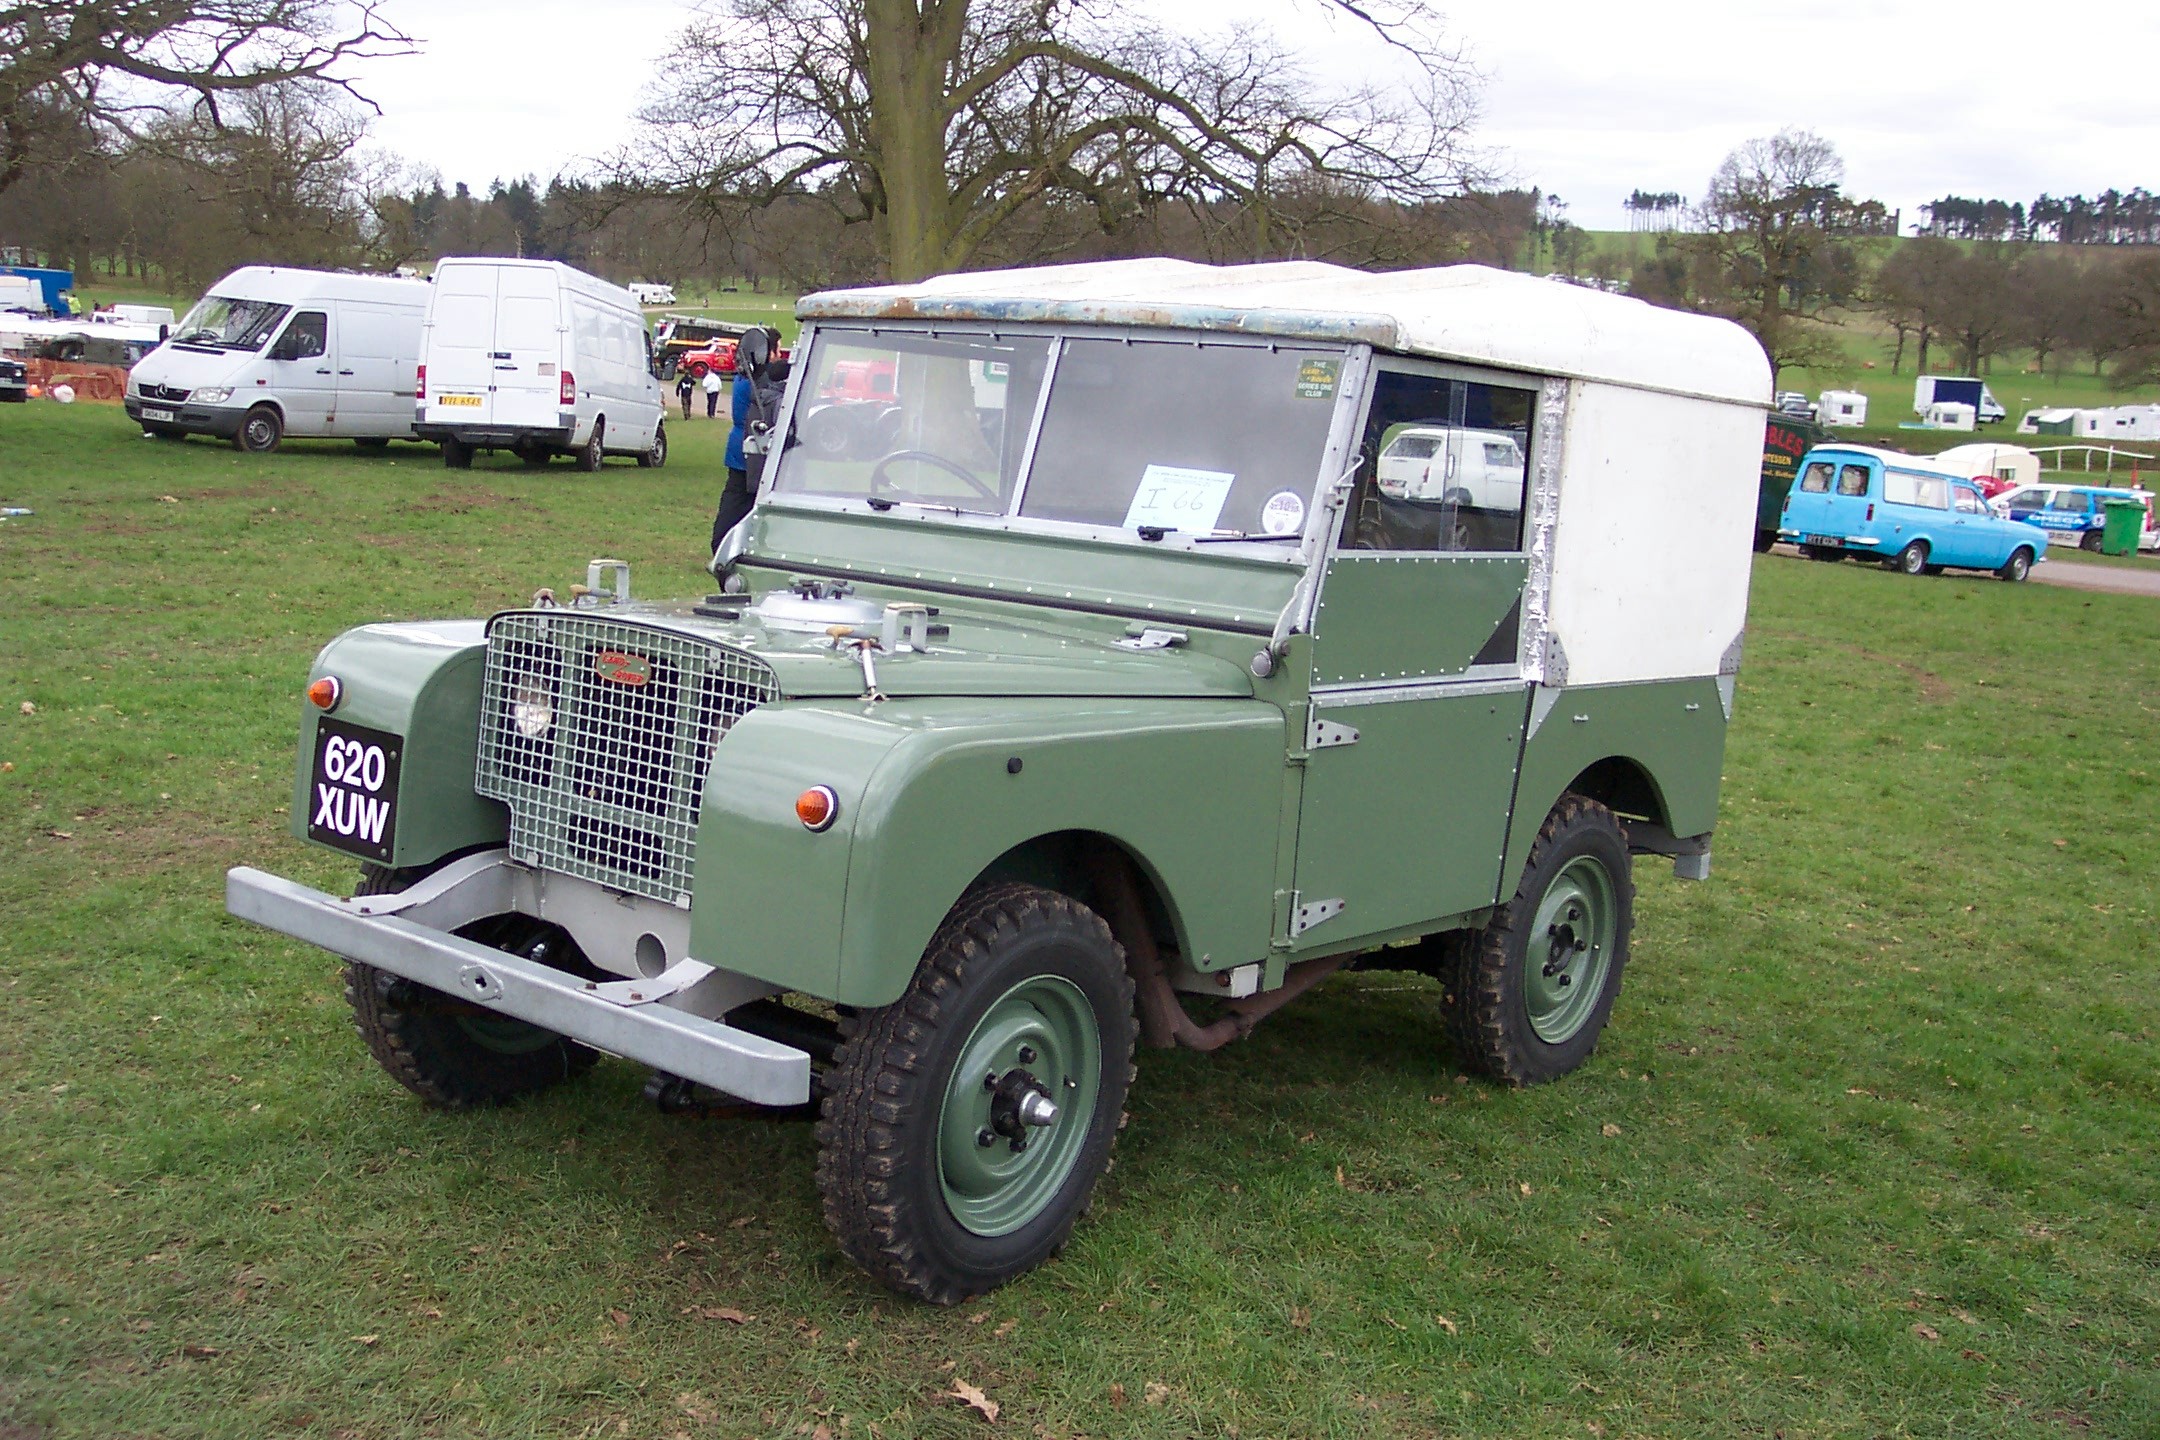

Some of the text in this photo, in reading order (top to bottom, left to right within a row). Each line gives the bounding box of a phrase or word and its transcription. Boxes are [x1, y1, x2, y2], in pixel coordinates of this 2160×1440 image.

[1173, 490, 1204, 511] 66
[324, 735, 386, 792] 620
[314, 782, 391, 844] XUW
